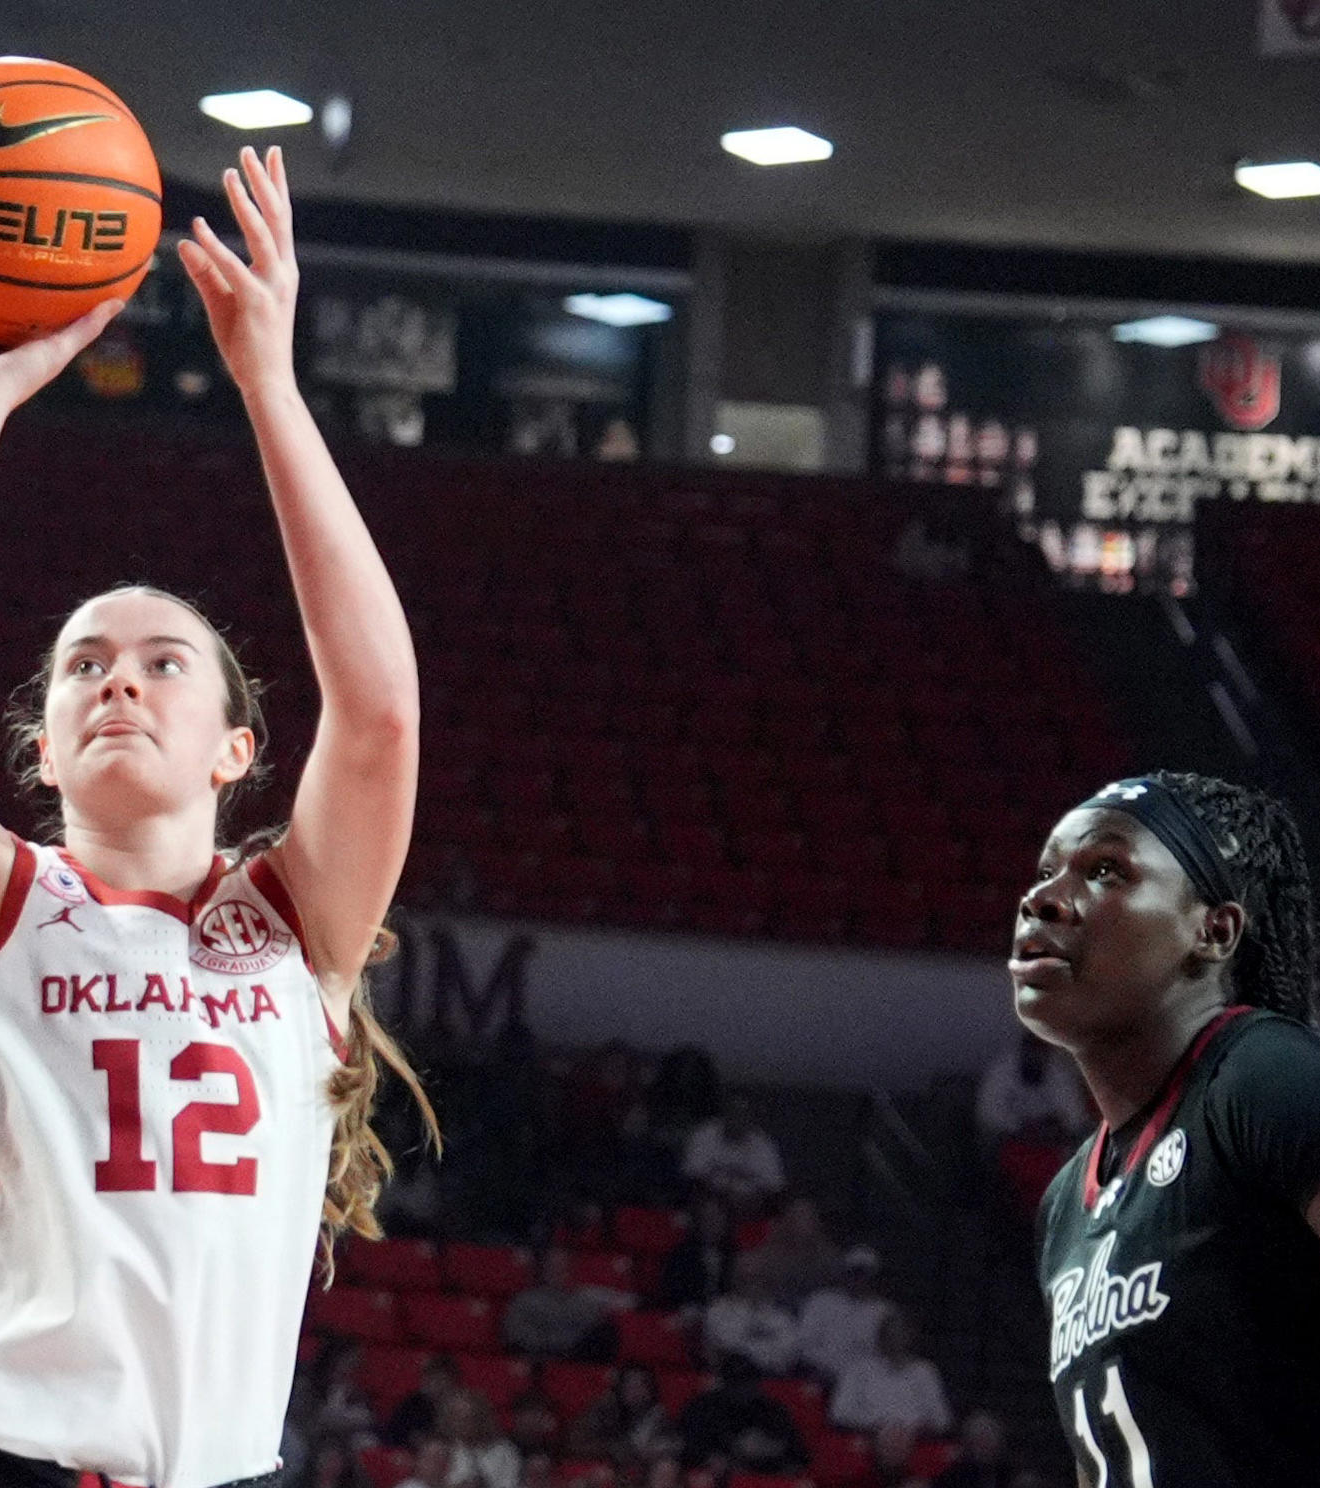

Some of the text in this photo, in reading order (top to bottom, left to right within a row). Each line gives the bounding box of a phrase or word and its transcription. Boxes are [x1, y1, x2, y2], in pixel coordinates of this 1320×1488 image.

[200, 901, 271, 956] SEC
[205, 945, 285, 972] GRADUATE
[92, 1039, 261, 1196] 12
